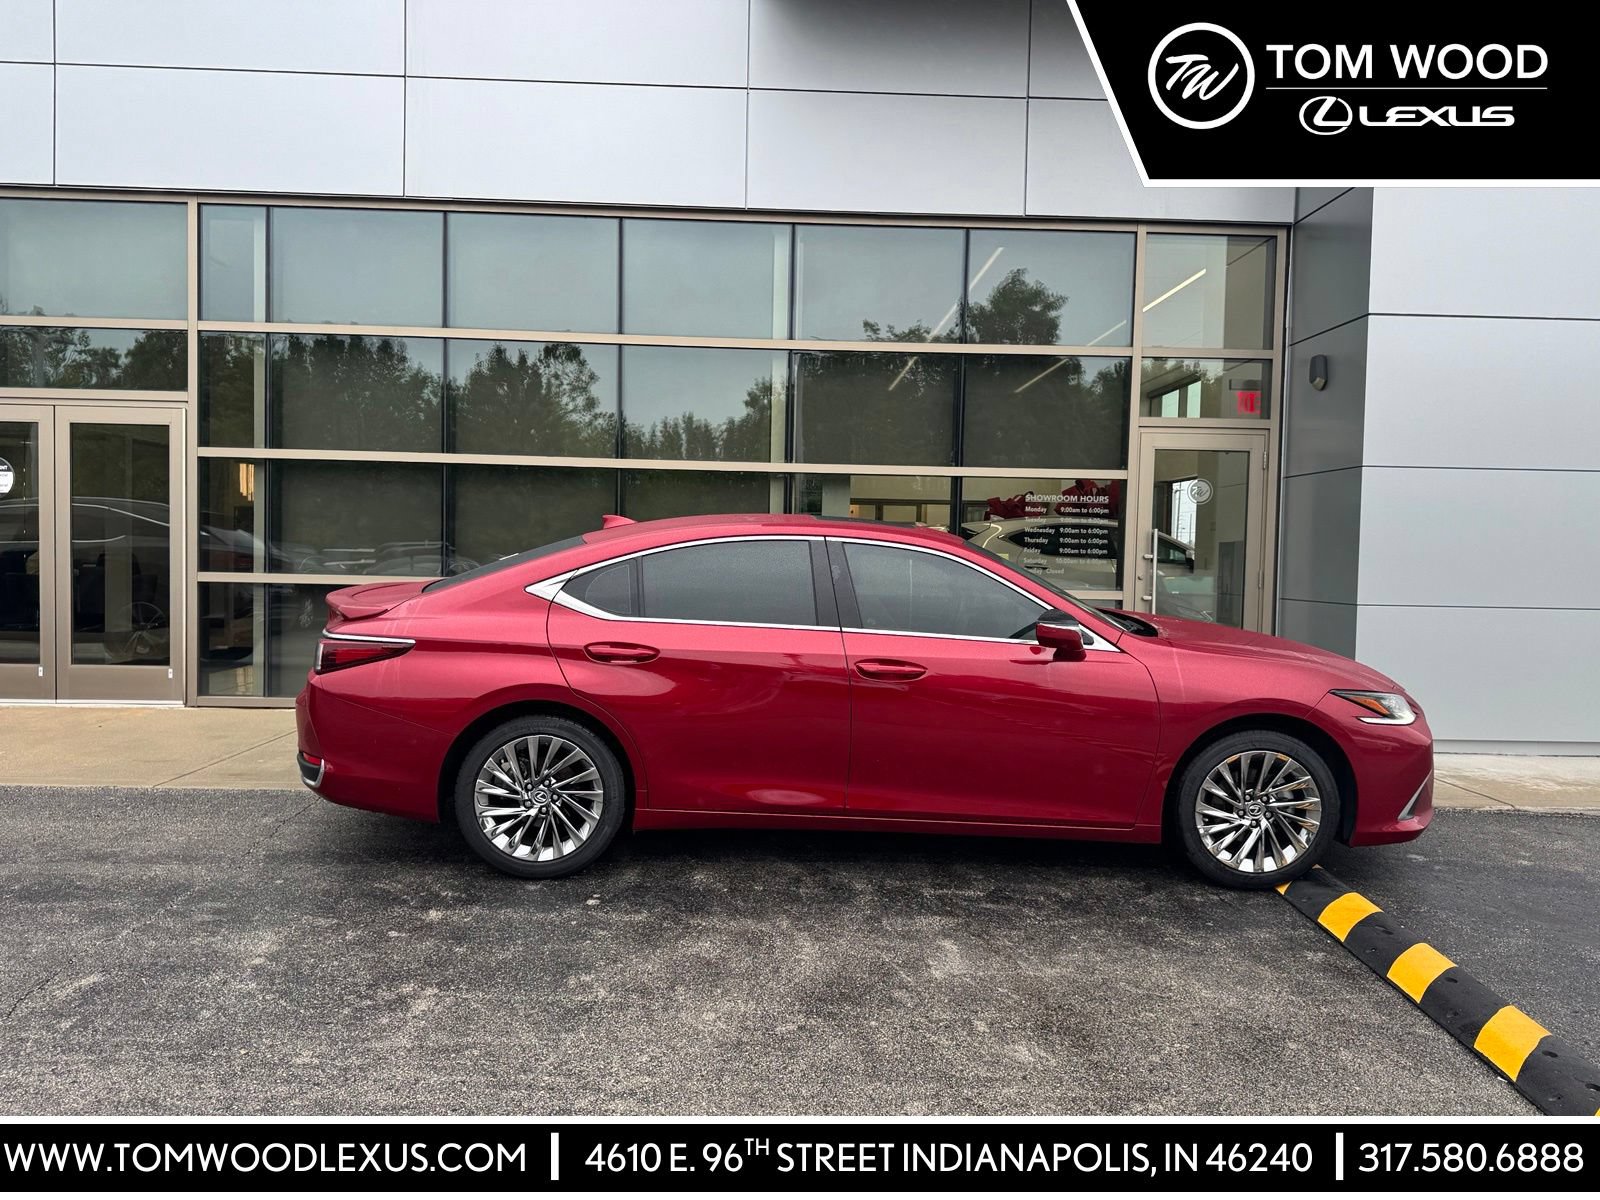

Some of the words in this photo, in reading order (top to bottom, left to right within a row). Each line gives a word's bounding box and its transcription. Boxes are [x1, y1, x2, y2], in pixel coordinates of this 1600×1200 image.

[1025, 494, 1078, 502] SHOWROOM
[1080, 495, 1109, 503] HOURS
[1024, 505, 1047, 514] Monday
[1088, 507, 1109, 515] 6:00pm
[1024, 526, 1055, 535] Wednesday
[1024, 536, 1048, 544] Thursday
[1023, 547, 1041, 555] Friday
